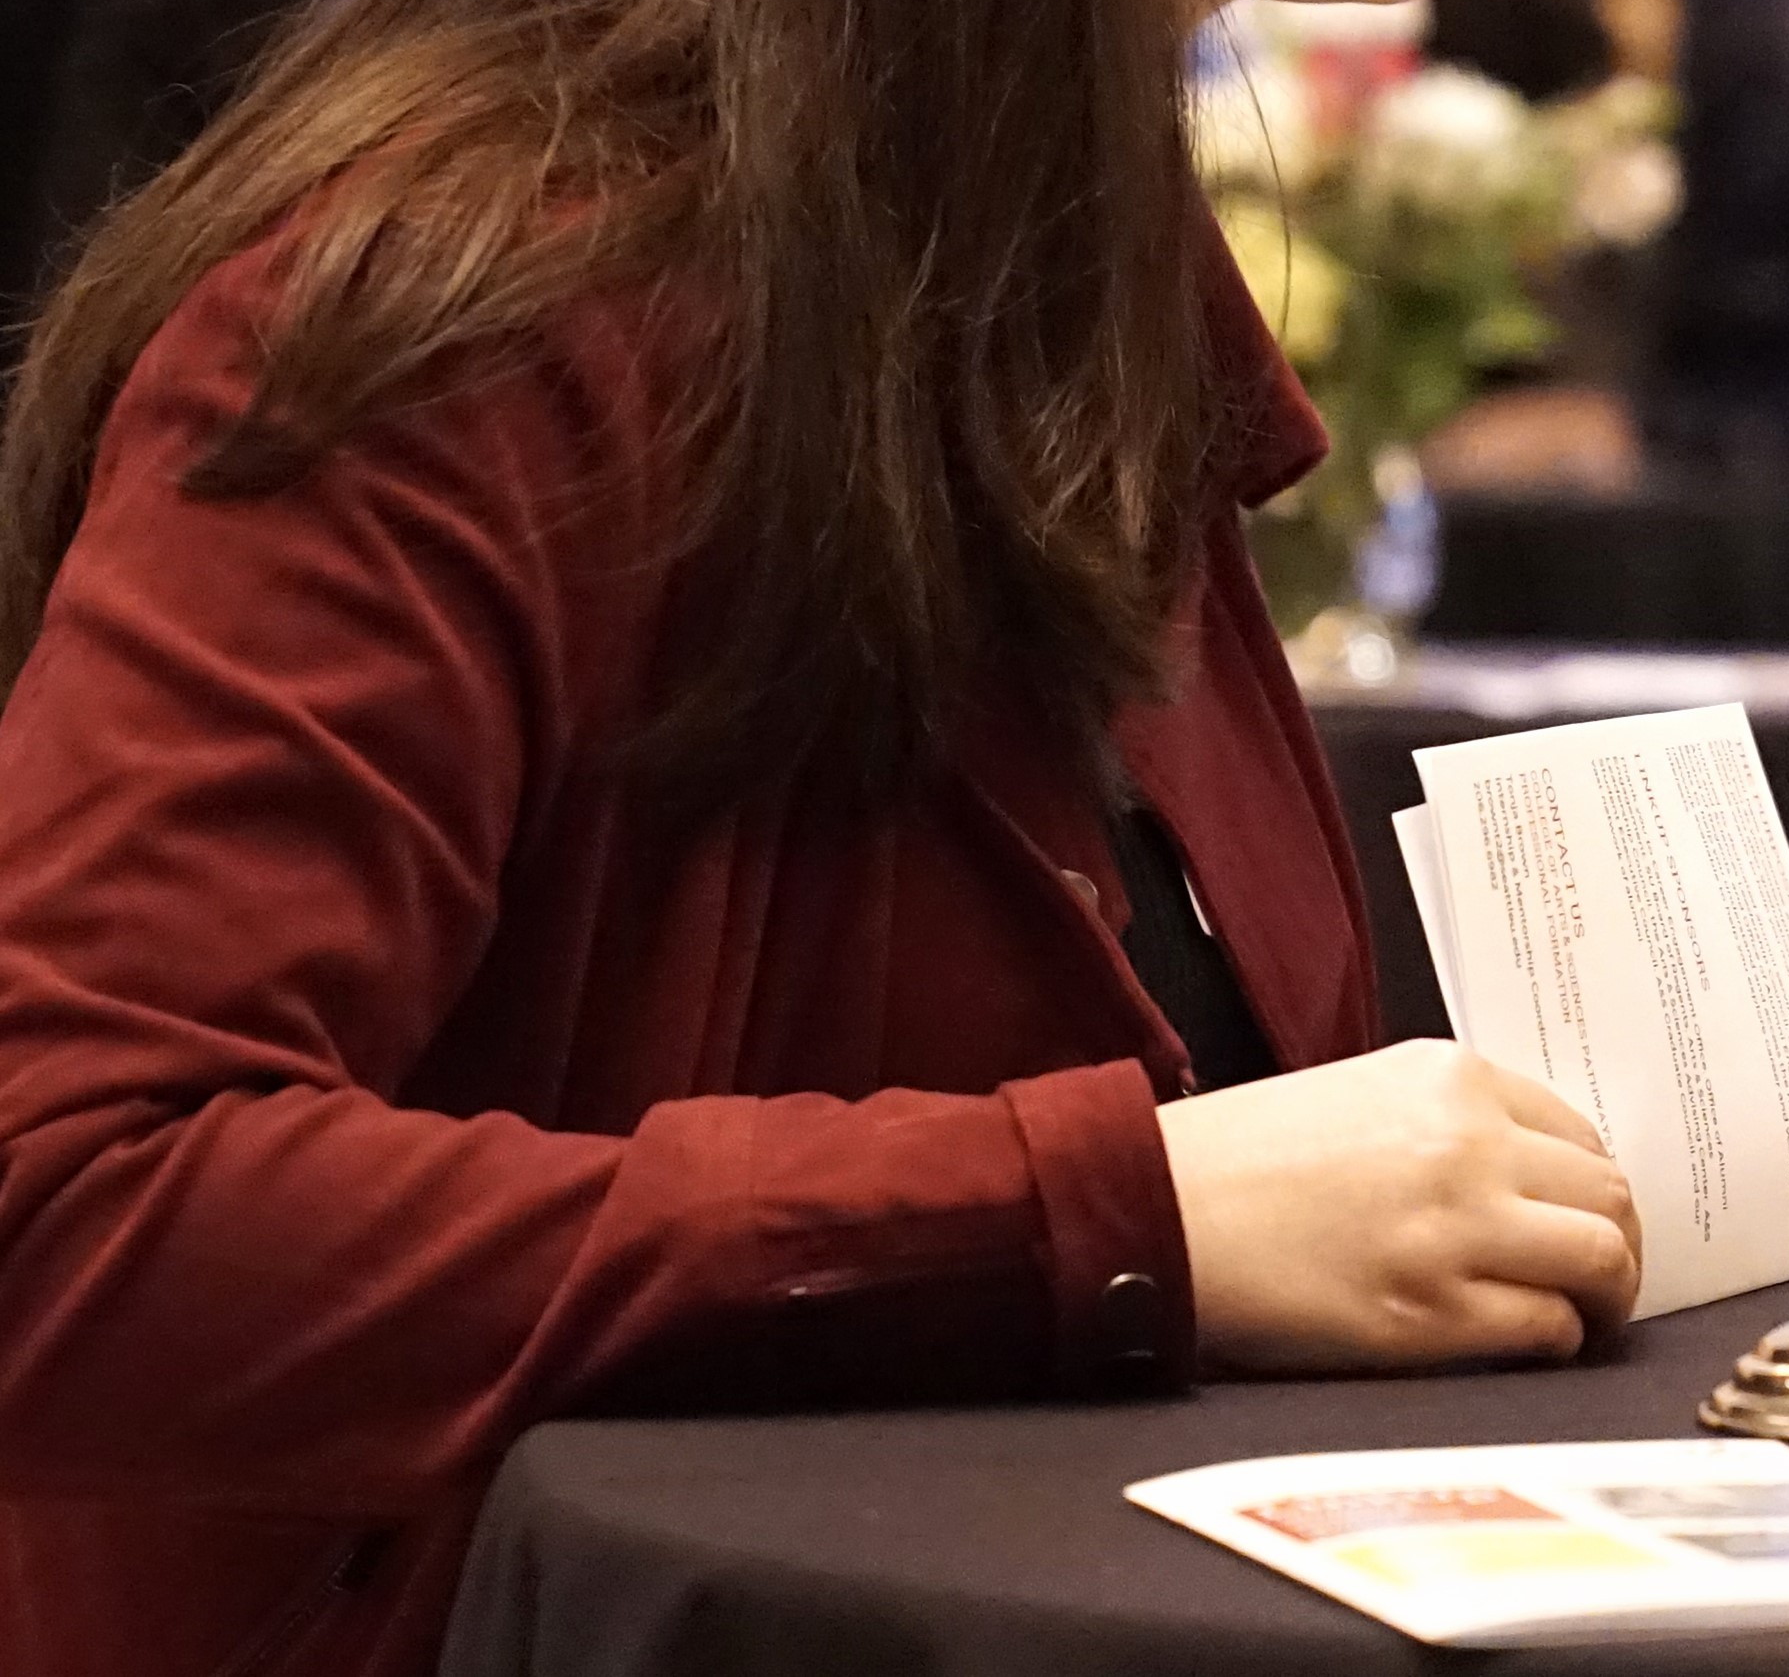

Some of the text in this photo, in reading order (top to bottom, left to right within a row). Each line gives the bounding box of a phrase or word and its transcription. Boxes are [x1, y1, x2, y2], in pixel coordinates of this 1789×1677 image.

[1619, 755, 1637, 802] Thank
[1504, 773, 1530, 879] Tonja Brown
[1590, 758, 1603, 789] vast
[1600, 794, 1623, 860] network
[1619, 865, 1629, 881] of
[1634, 806, 1648, 835] you
[1645, 839, 1653, 856] to
[1540, 767, 1585, 938] CONTACT US
[1633, 753, 1710, 991] LINKUP SPONSORS
[1644, 865, 1655, 887] SU
[1517, 772, 1572, 1024] PROFESSIONAL FORMATION
[1651, 859, 1669, 910] Career
[1651, 891, 1669, 938] Board
[1494, 776, 1554, 1080] Internship & Mentorship Coordinator
[1665, 942, 1675, 958] of
[1529, 769, 1616, 1162] COLLEGE OF ARTS & SCIENCES PATHWAYS T
[1598, 757, 1620, 820] Student
[1617, 825, 1642, 903] Executive
[1654, 975, 1668, 1009] A&S
[1663, 1012, 1683, 1088] Graduate
[1690, 1162, 1700, 1194] and
[1666, 915, 1697, 1018] Engagement
[1604, 756, 1634, 843] Leadership
[1649, 915, 1660, 942] the
[1656, 946, 1669, 979] Arts
[1665, 982, 1673, 993] &
[1669, 997, 1688, 1068] Sciences
[1684, 1072, 1702, 1142] Advising
[1703, 1209, 1711, 1242] A&S
[1686, 1036, 1697, 1069] Arts
[1694, 1073, 1701, 1084] &
[1696, 1087, 1714, 1159] Sciences
[1704, 1077, 1718, 1126] Office
[1714, 1129, 1723, 1145] of
[1716, 1149, 1728, 1210] Alumni
